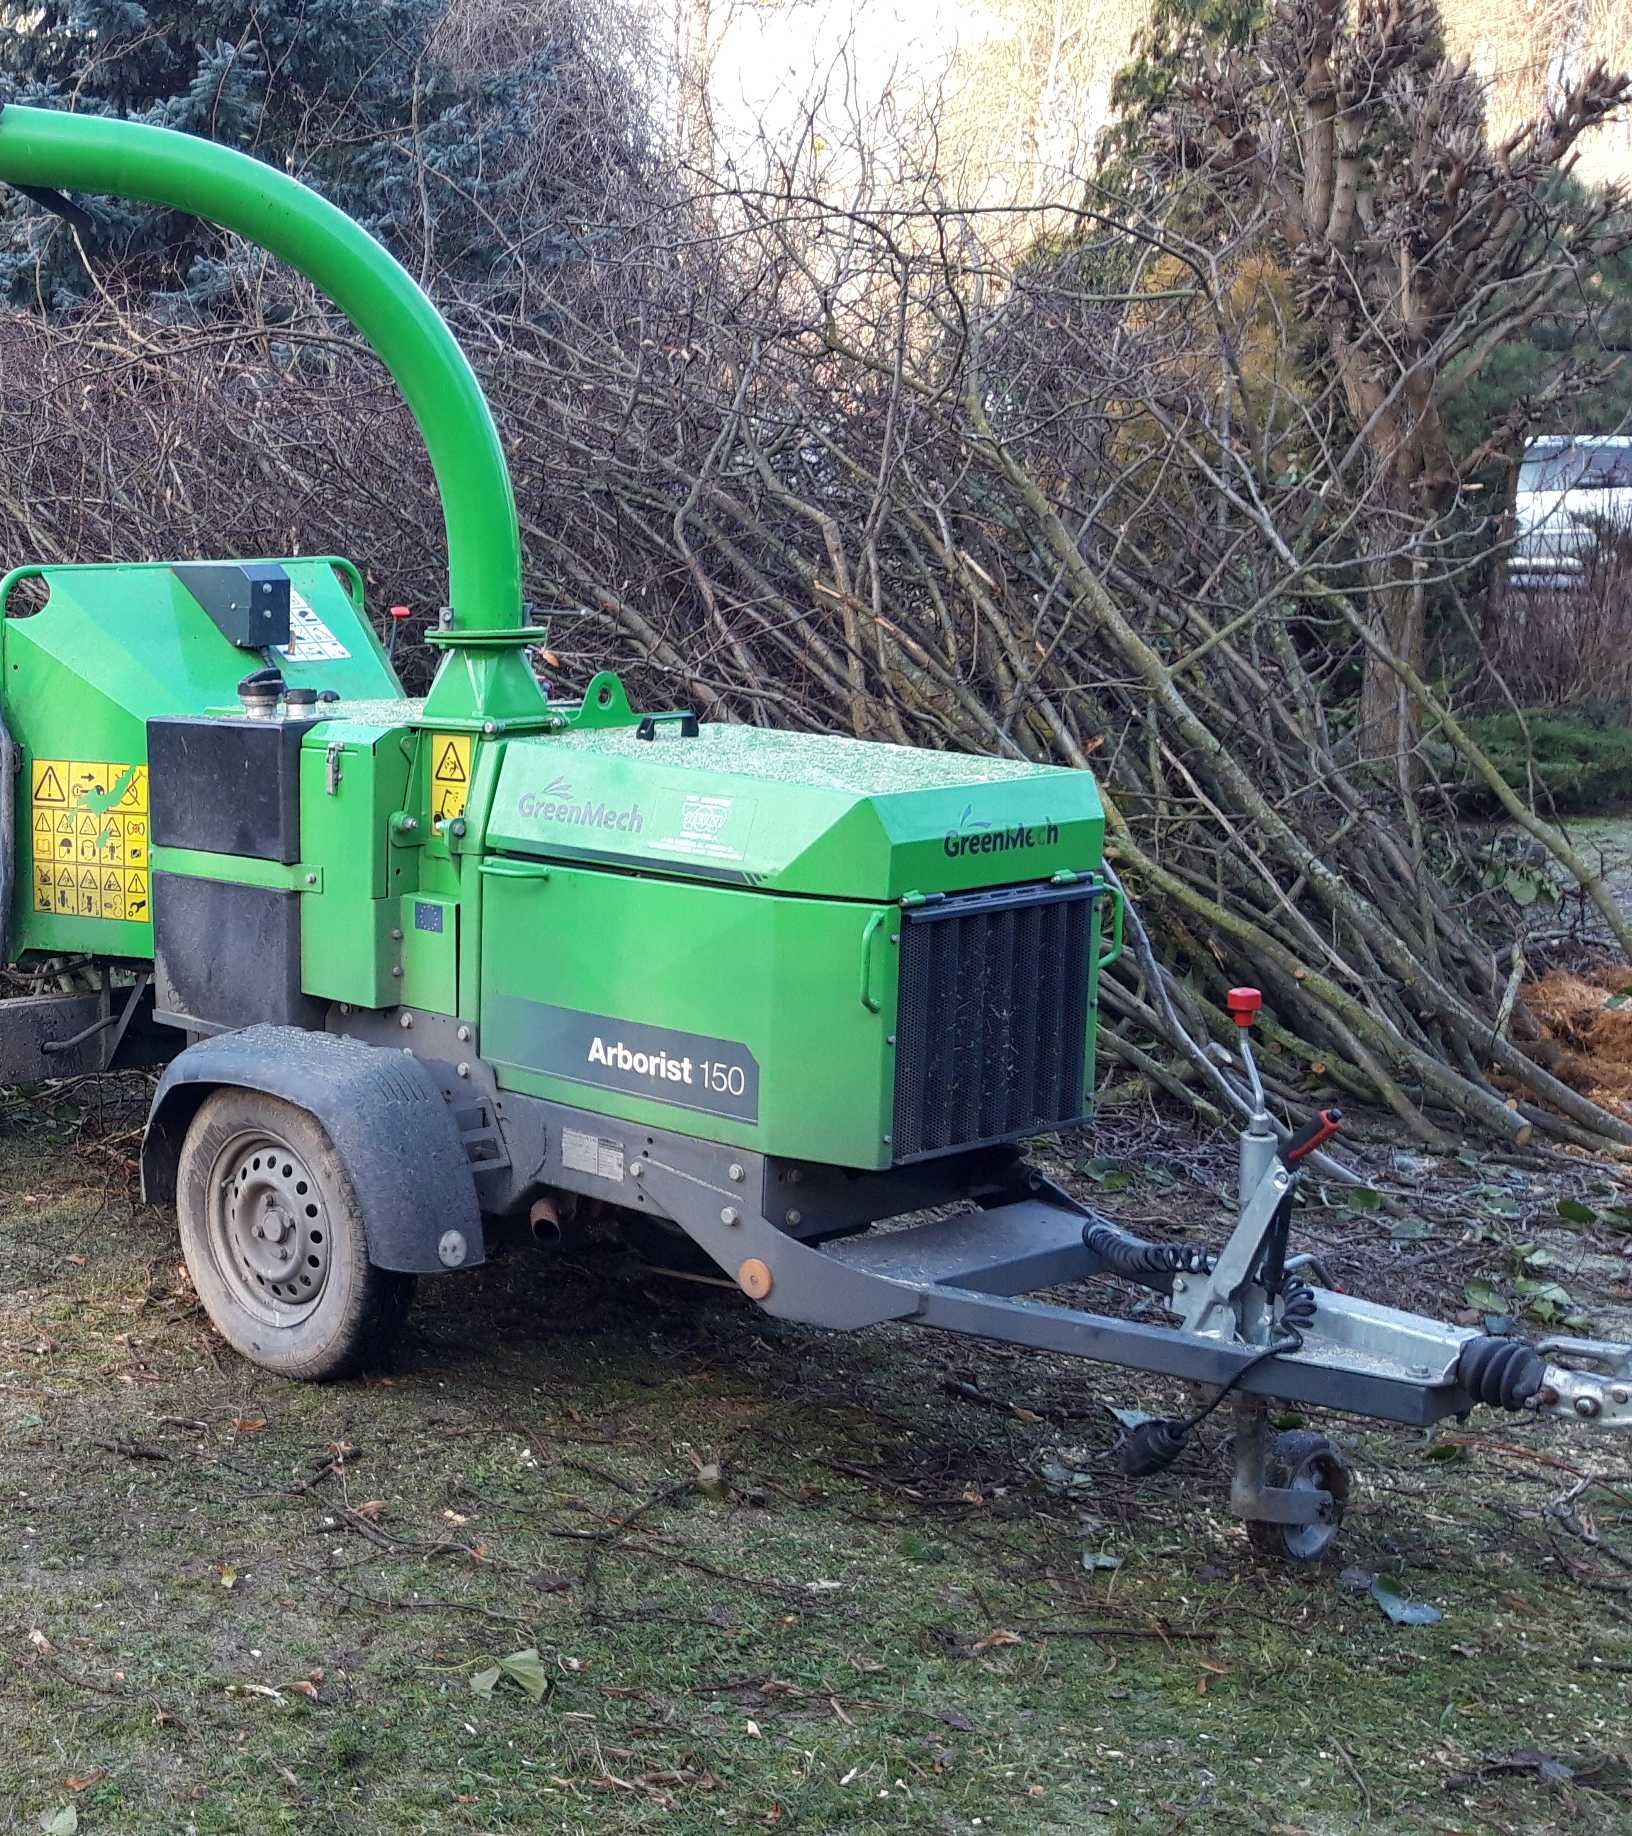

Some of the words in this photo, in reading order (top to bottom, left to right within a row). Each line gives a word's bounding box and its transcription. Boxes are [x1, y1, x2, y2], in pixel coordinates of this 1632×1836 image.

[519, 792, 643, 832] GreenMech
[944, 815, 1058, 857] GreenMeh
[588, 1037, 692, 1084] Arborist
[699, 1060, 745, 1096] 150
